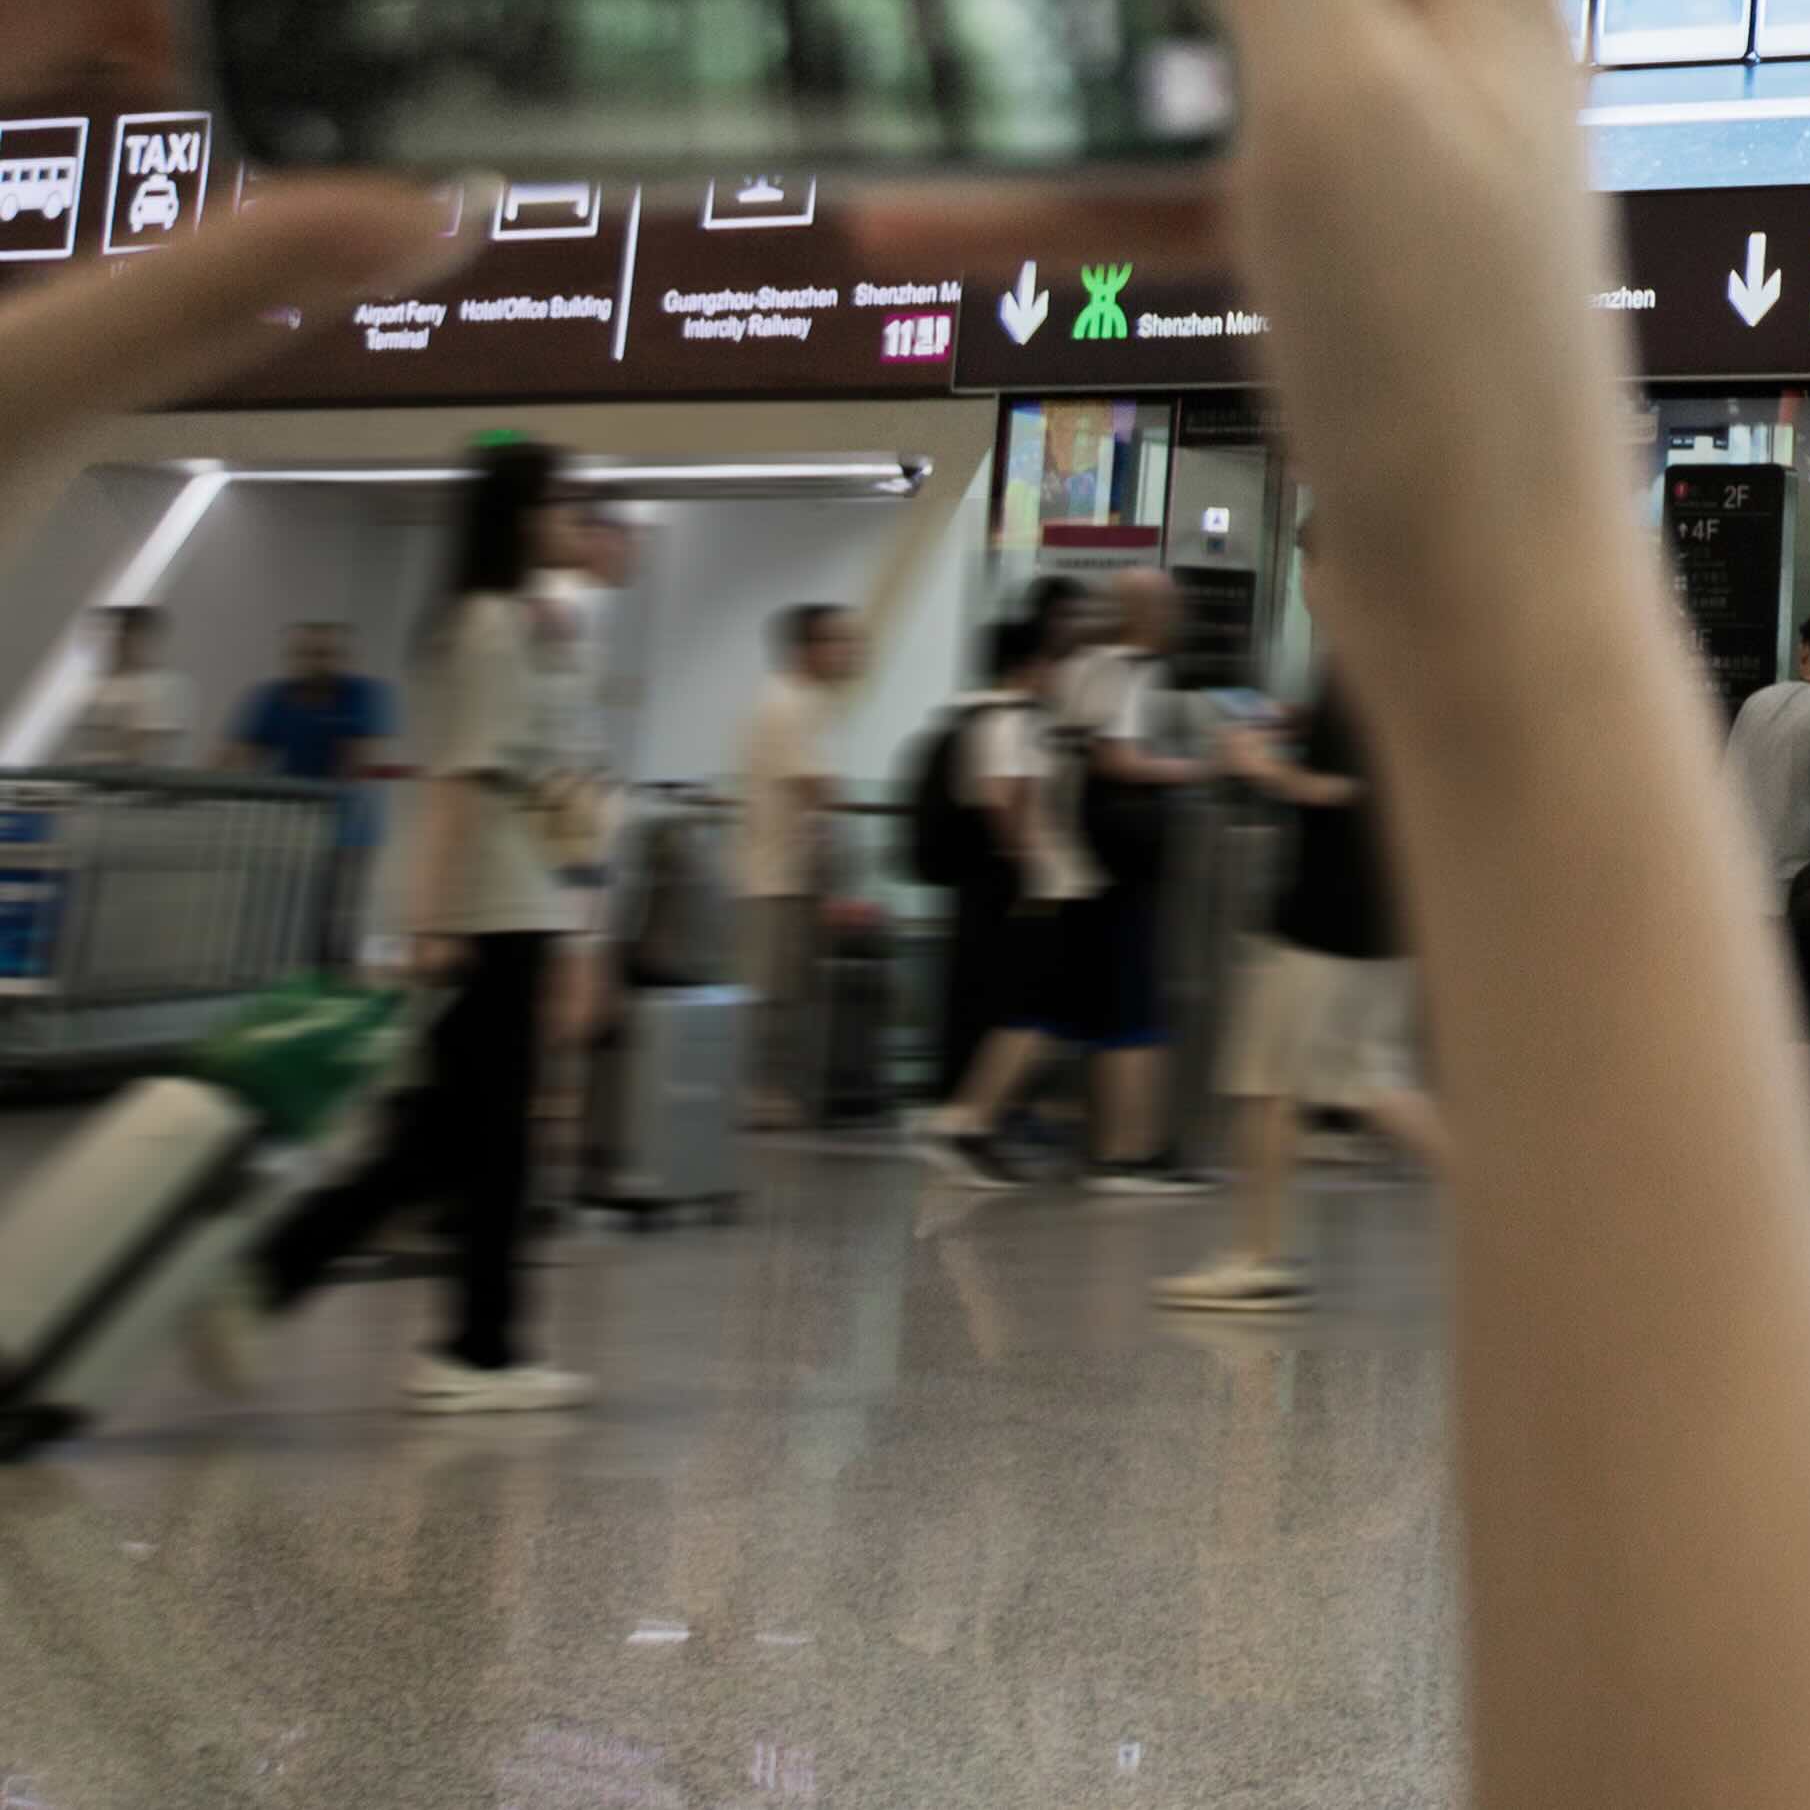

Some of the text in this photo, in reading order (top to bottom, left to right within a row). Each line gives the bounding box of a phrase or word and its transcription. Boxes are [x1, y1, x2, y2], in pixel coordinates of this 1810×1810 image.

[125, 131, 201, 175] TAXI
[549, 294, 614, 323] Building
[662, 285, 839, 317] Guangzhou-Shenzhen
[853, 282, 937, 307] Shenzhen
[354, 300, 448, 328] Airport Ferry
[683, 313, 812, 343] Intercity Railway
[1136, 311, 1224, 339] Shenzhen
[365, 327, 431, 351] Terminal
[1723, 484, 1750, 510] 2F
[1691, 518, 1720, 542] 4F
